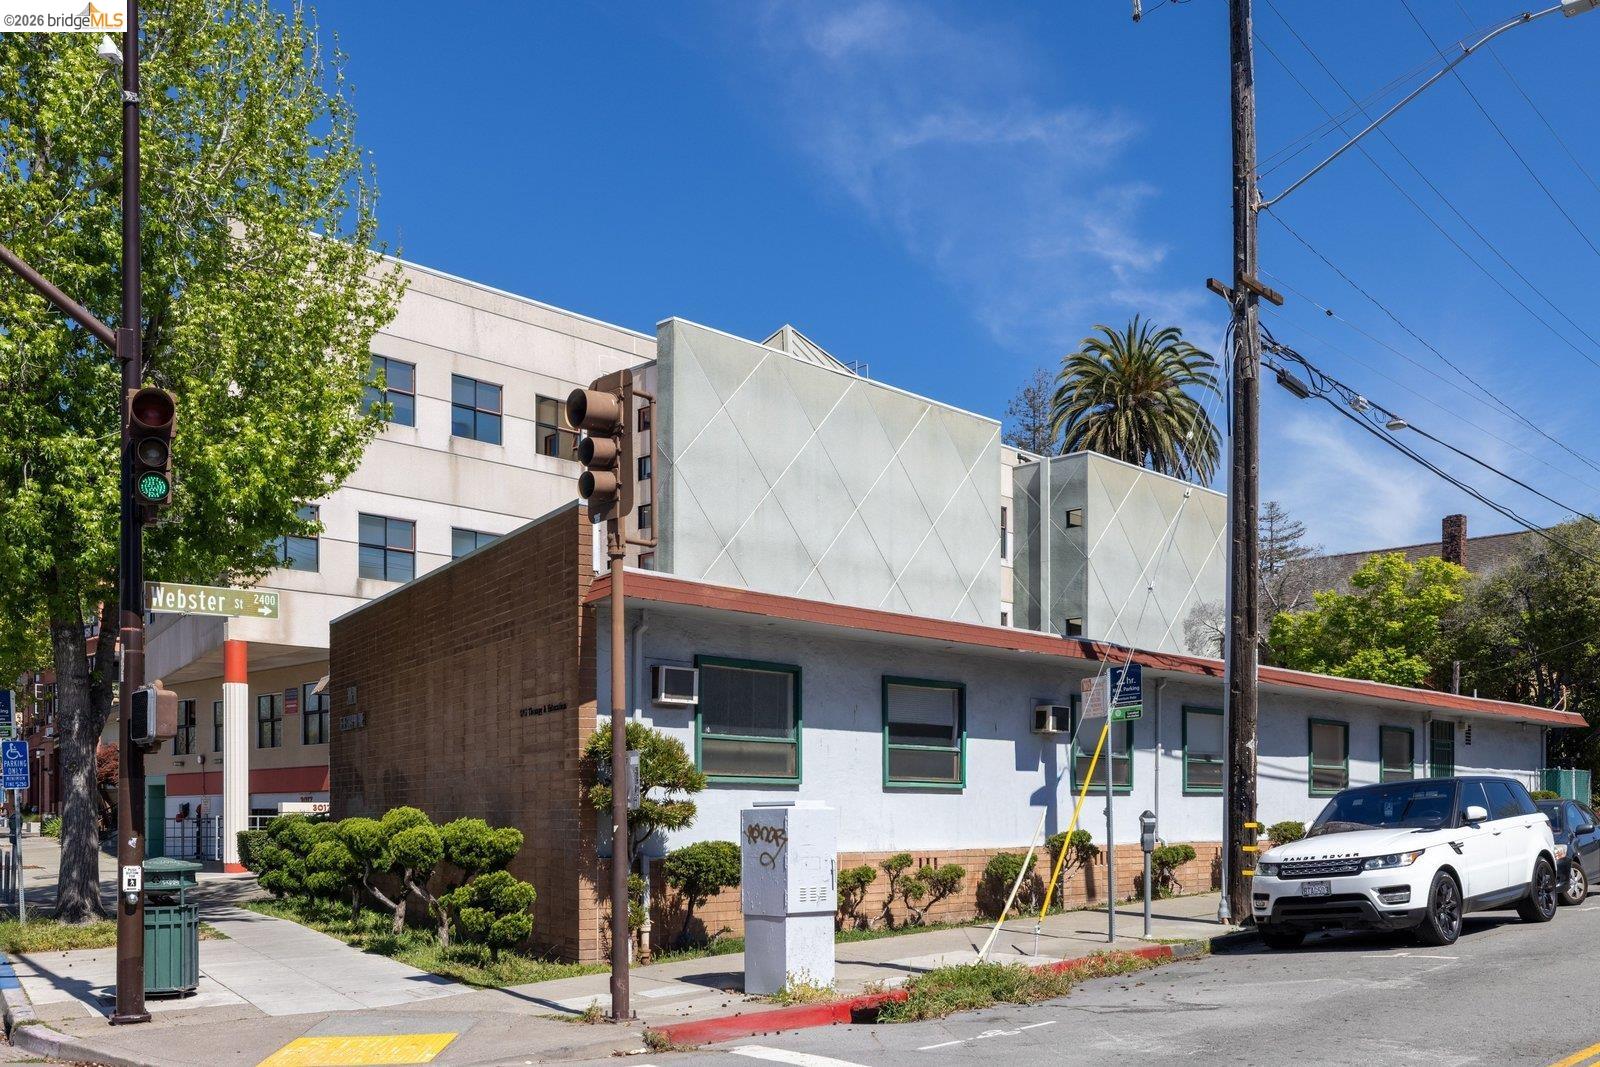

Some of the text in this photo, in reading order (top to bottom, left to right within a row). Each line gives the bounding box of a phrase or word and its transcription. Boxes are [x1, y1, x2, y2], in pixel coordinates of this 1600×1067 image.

[151, 586, 276, 612] Webster St 2400
[1126, 676, 1137, 685] hr.
[8, 767, 23, 775] ONLY
